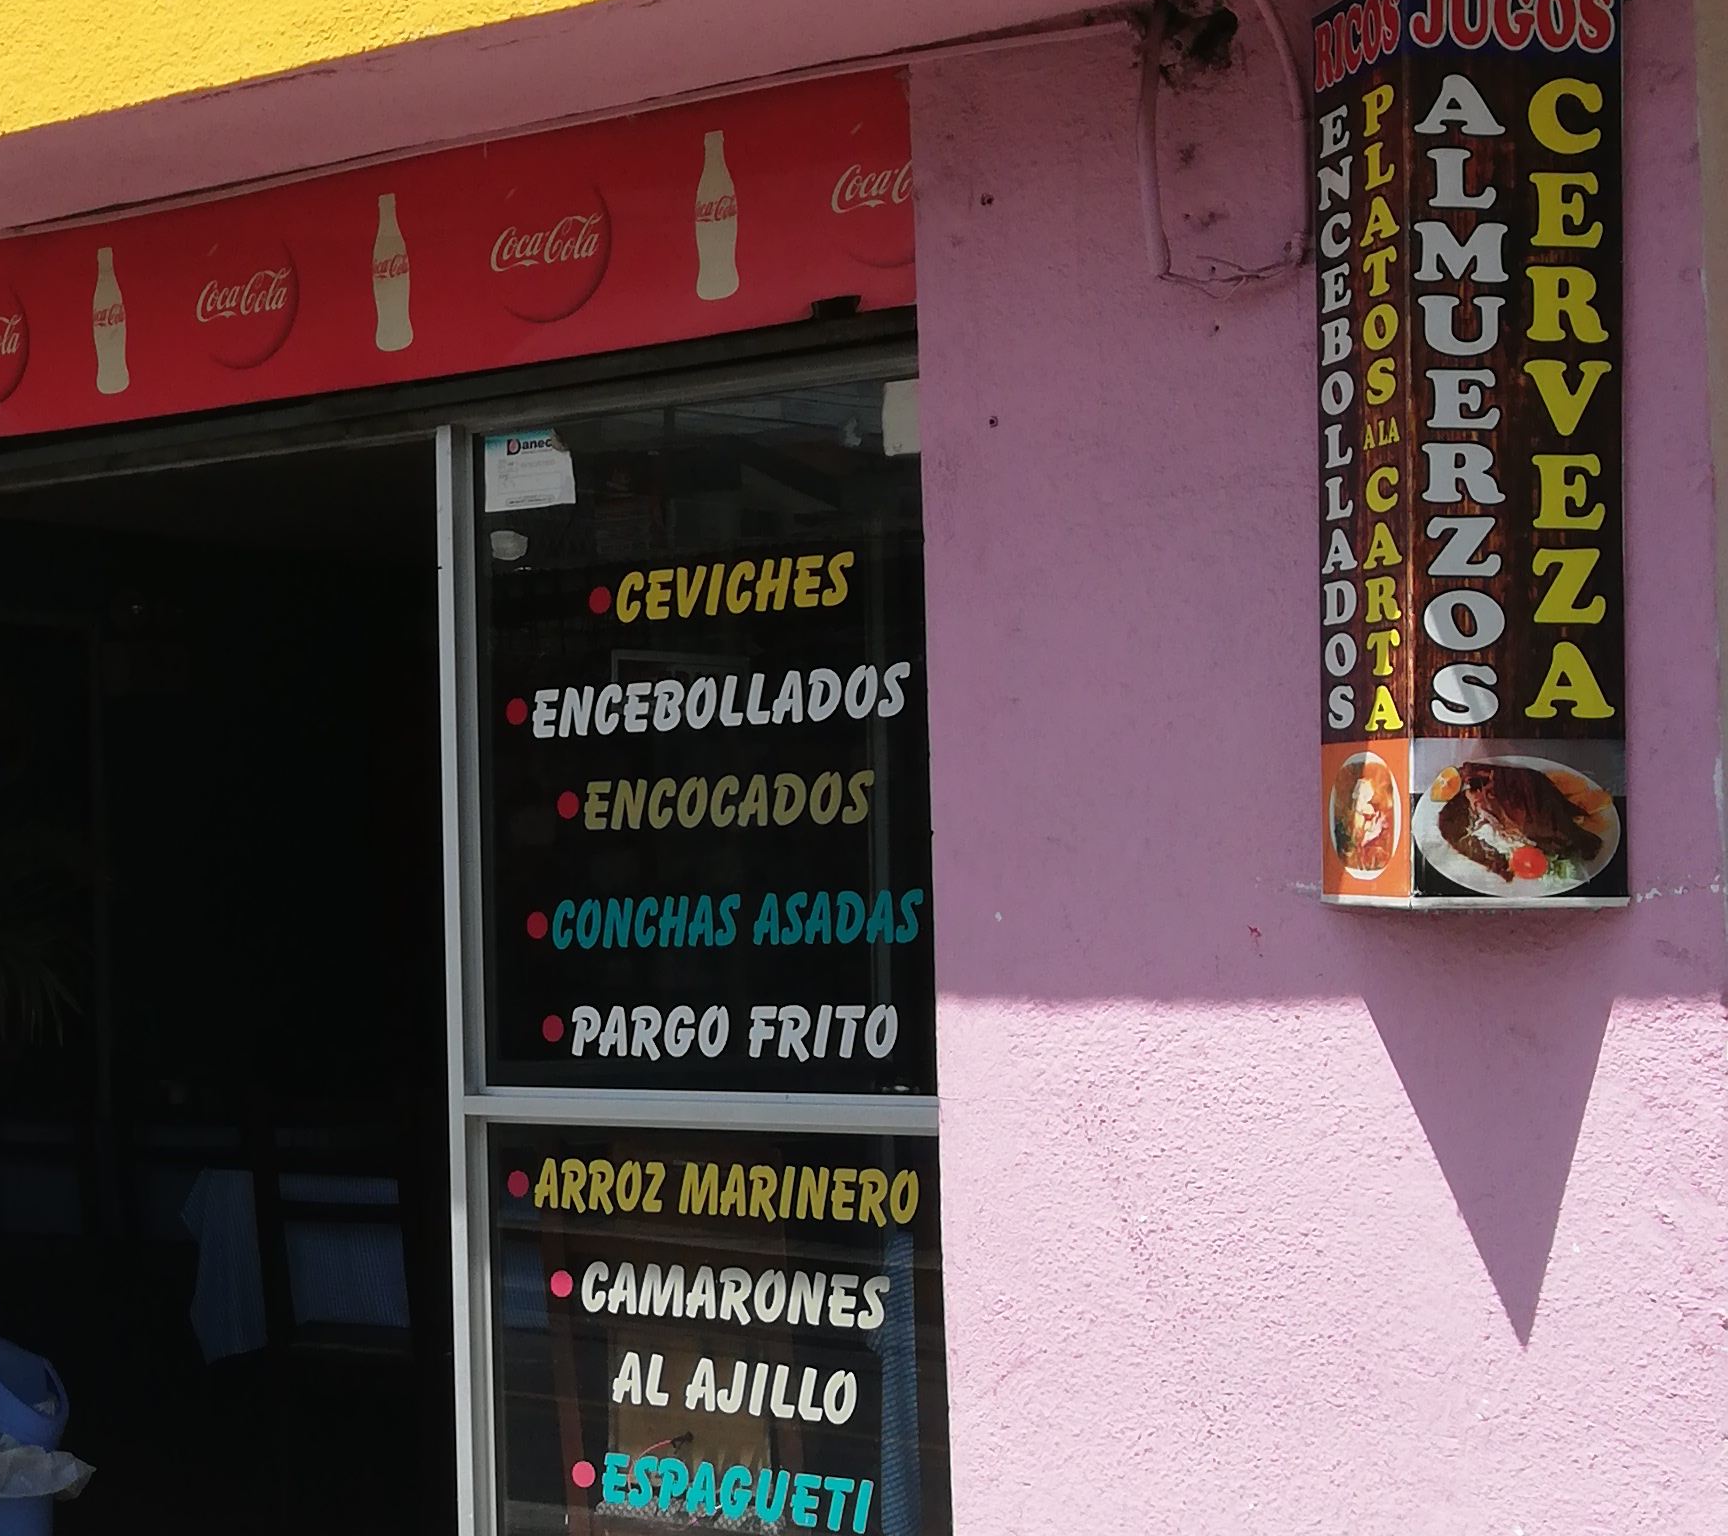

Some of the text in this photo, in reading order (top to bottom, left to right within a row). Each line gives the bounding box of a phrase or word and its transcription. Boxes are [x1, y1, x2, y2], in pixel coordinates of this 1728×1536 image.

[1317, 104, 1358, 731] ENCEBOLLADOS
[1360, 83, 1404, 731] PLATOS A LA CARTA
[1414, 74, 1509, 726] ALMUERZOS
[1524, 77, 1616, 720] CERVEZA
[616, 551, 855, 623] CEVICHES
[532, 662, 911, 739] ENCEBOLLADOS
[583, 770, 875, 831] ENCOCADOS
[552, 889, 924, 950] CONCHAS ASADAS
[571, 1004, 899, 1062] PARGO FRITO
[534, 1158, 920, 1227] ARROZ MARINERO
[581, 1261, 891, 1330] CAMARONES
[612, 1351, 857, 1425] AL AJILLO
[601, 1451, 874, 1535] ESPAGUETI
